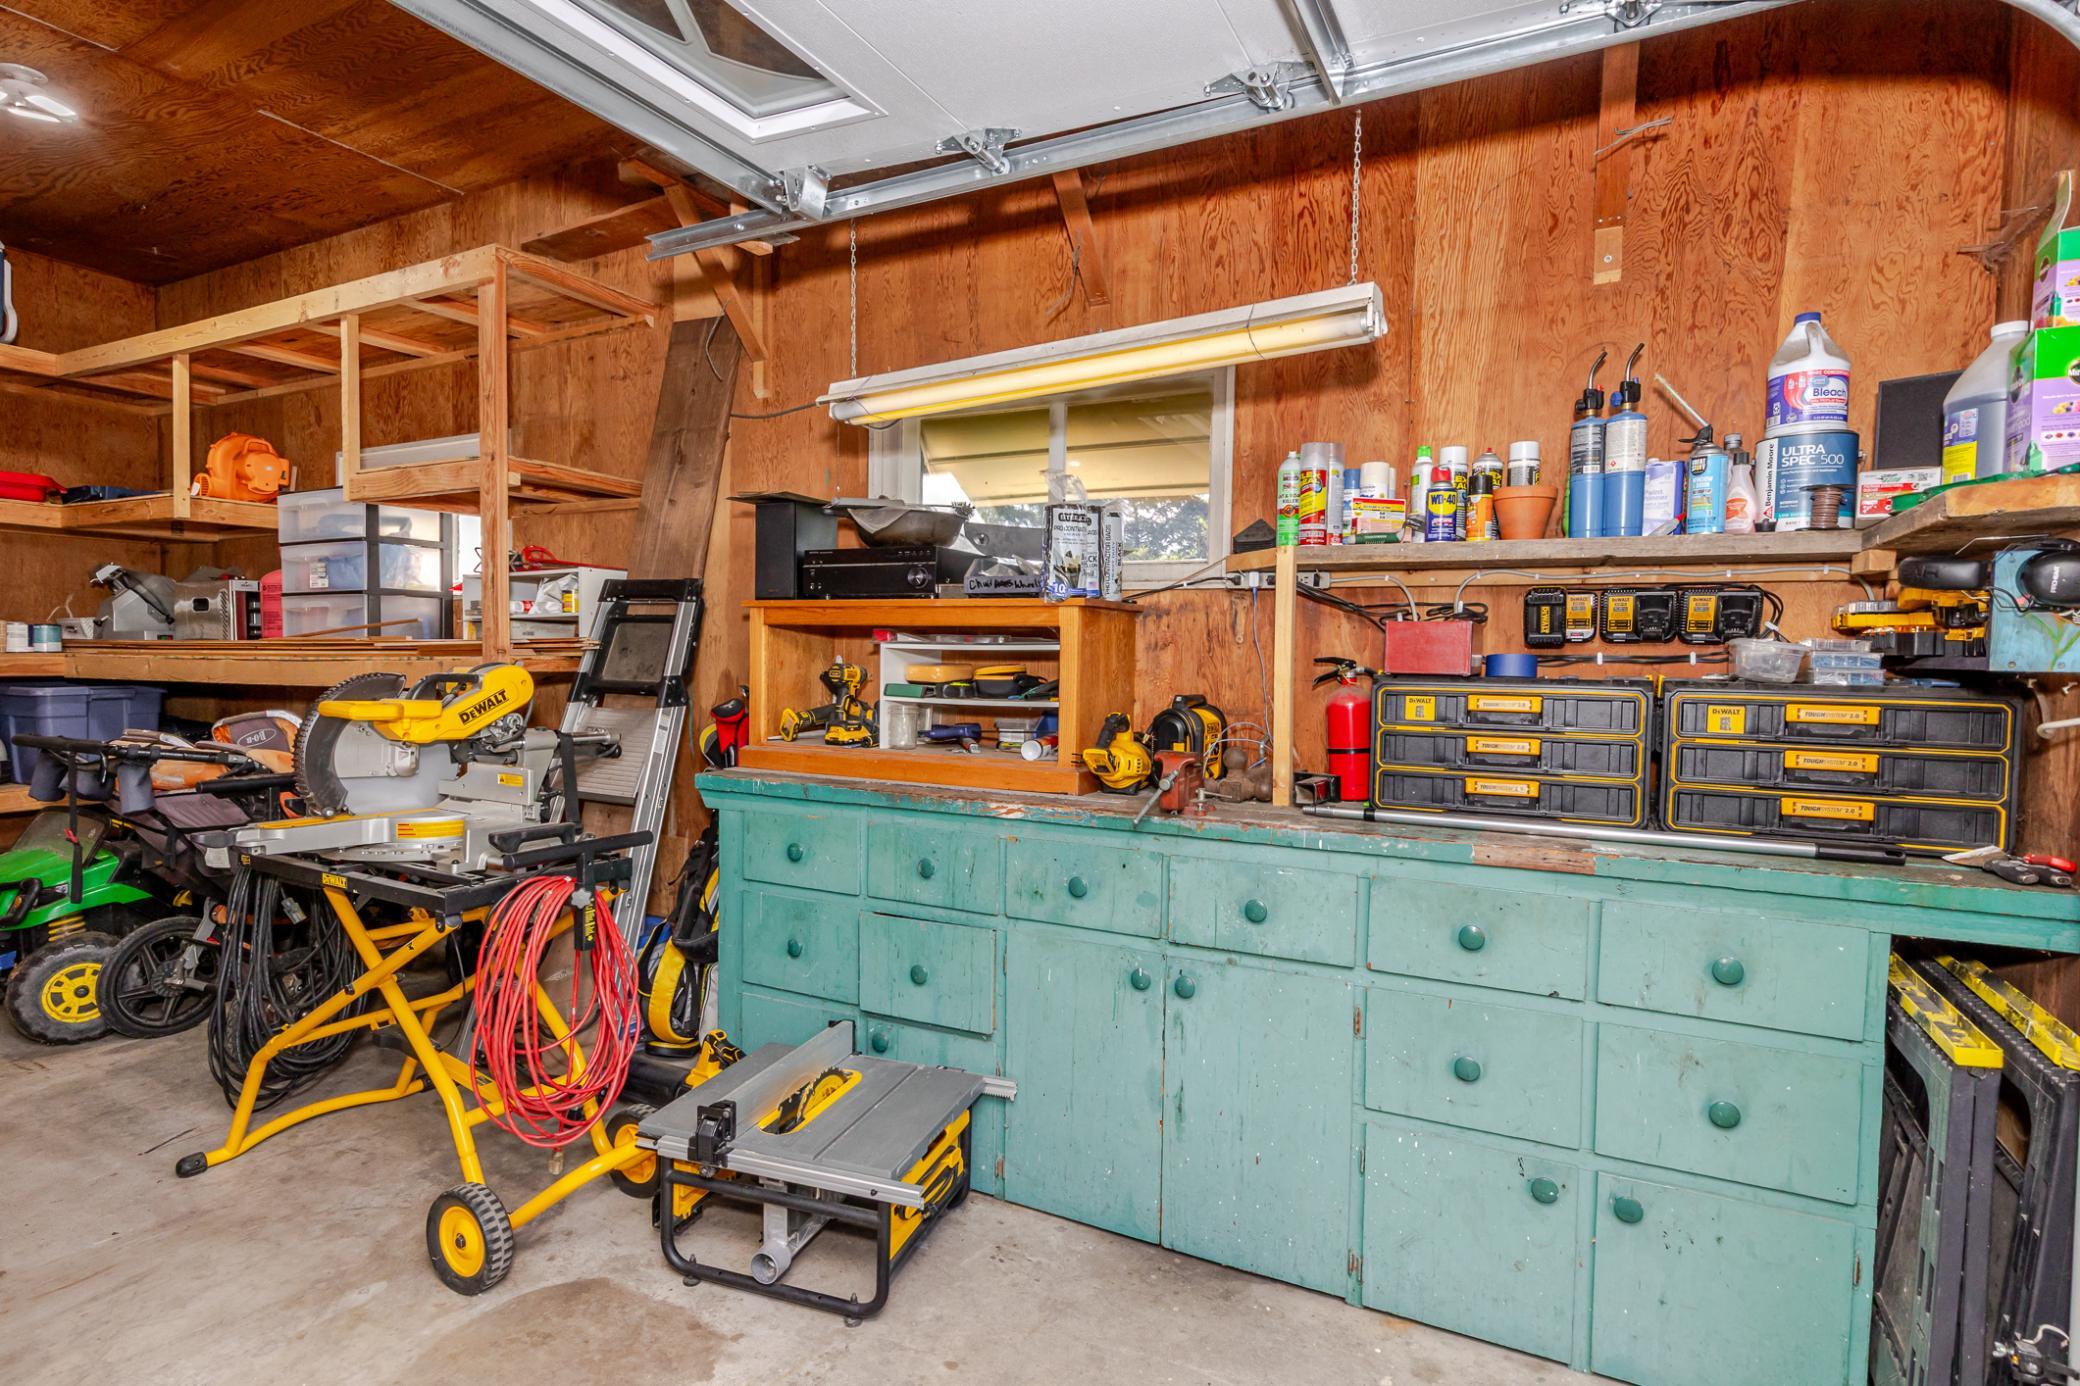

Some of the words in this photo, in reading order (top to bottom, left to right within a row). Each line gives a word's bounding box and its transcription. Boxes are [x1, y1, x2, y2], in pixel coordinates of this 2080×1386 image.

[1813, 387, 1847, 398] Bleach
[1767, 443, 1775, 469] Moore
[1782, 444, 1826, 457] ULTRA
[1781, 455, 1816, 468] SPEC
[1820, 454, 1845, 465] 500
[1765, 470, 1774, 506] Benjamin
[1431, 494, 1456, 505] WD-40
